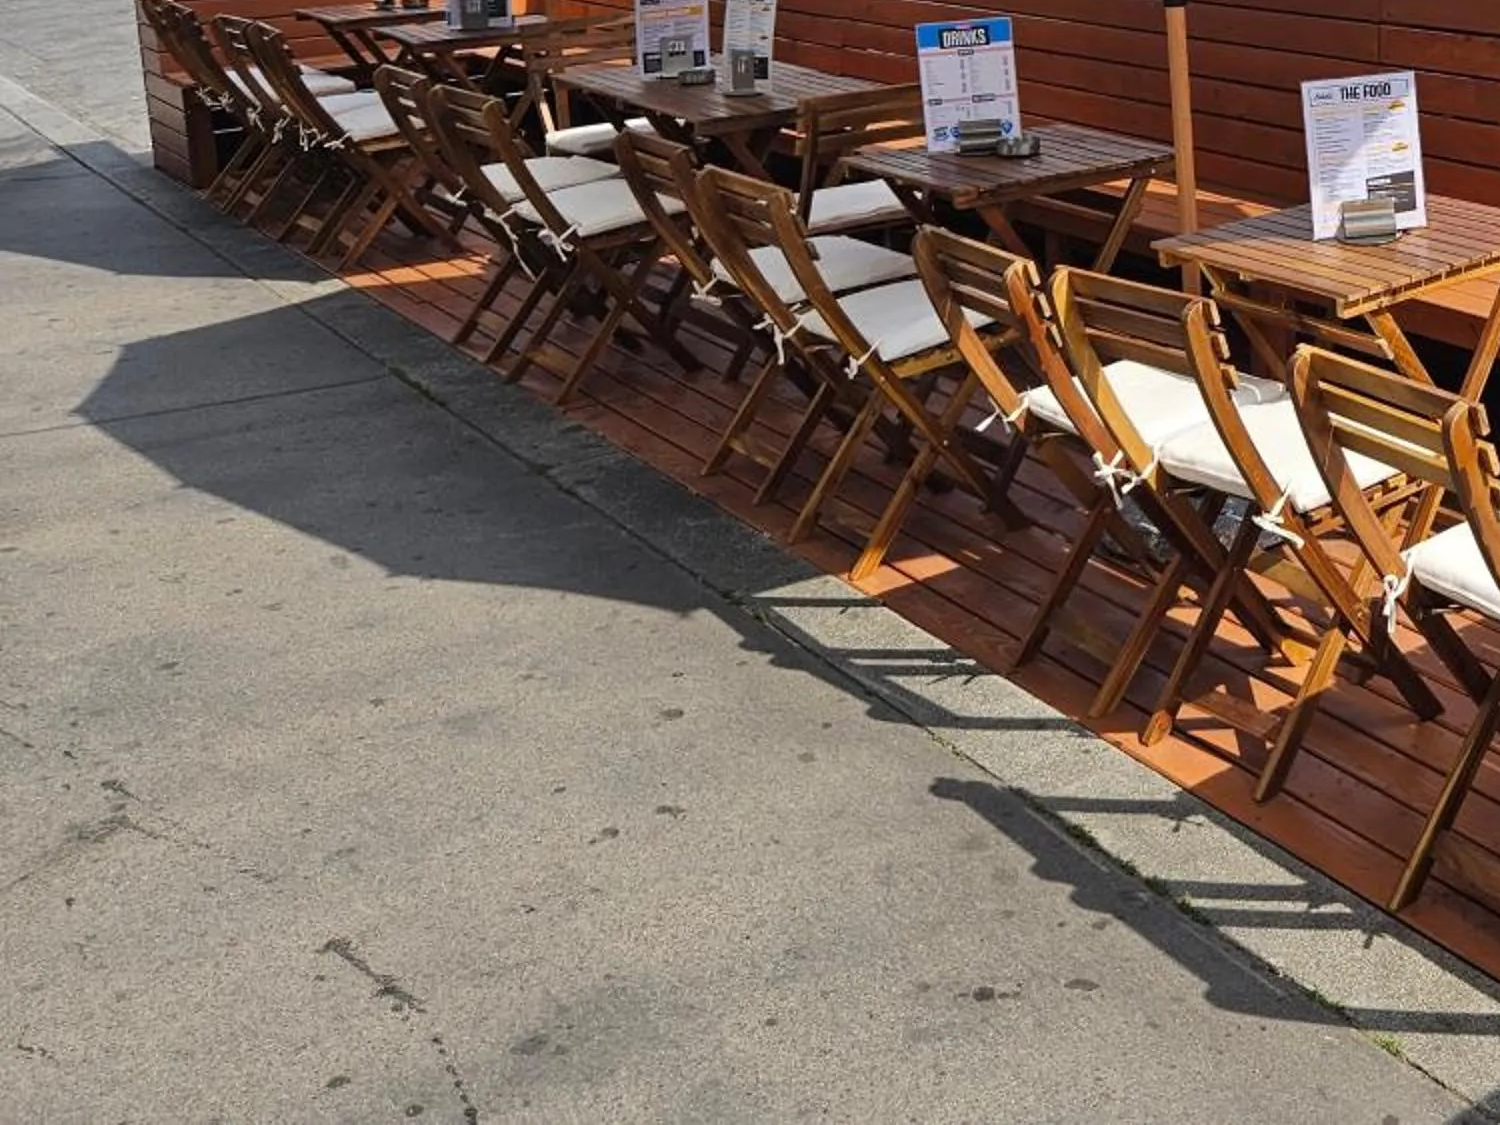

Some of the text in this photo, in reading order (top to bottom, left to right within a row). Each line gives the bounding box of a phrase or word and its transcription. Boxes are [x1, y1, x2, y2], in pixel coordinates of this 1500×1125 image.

[943, 28, 987, 47] DRINKS
[1340, 86, 1361, 100] THE
[1363, 82, 1391, 98] FOOD
